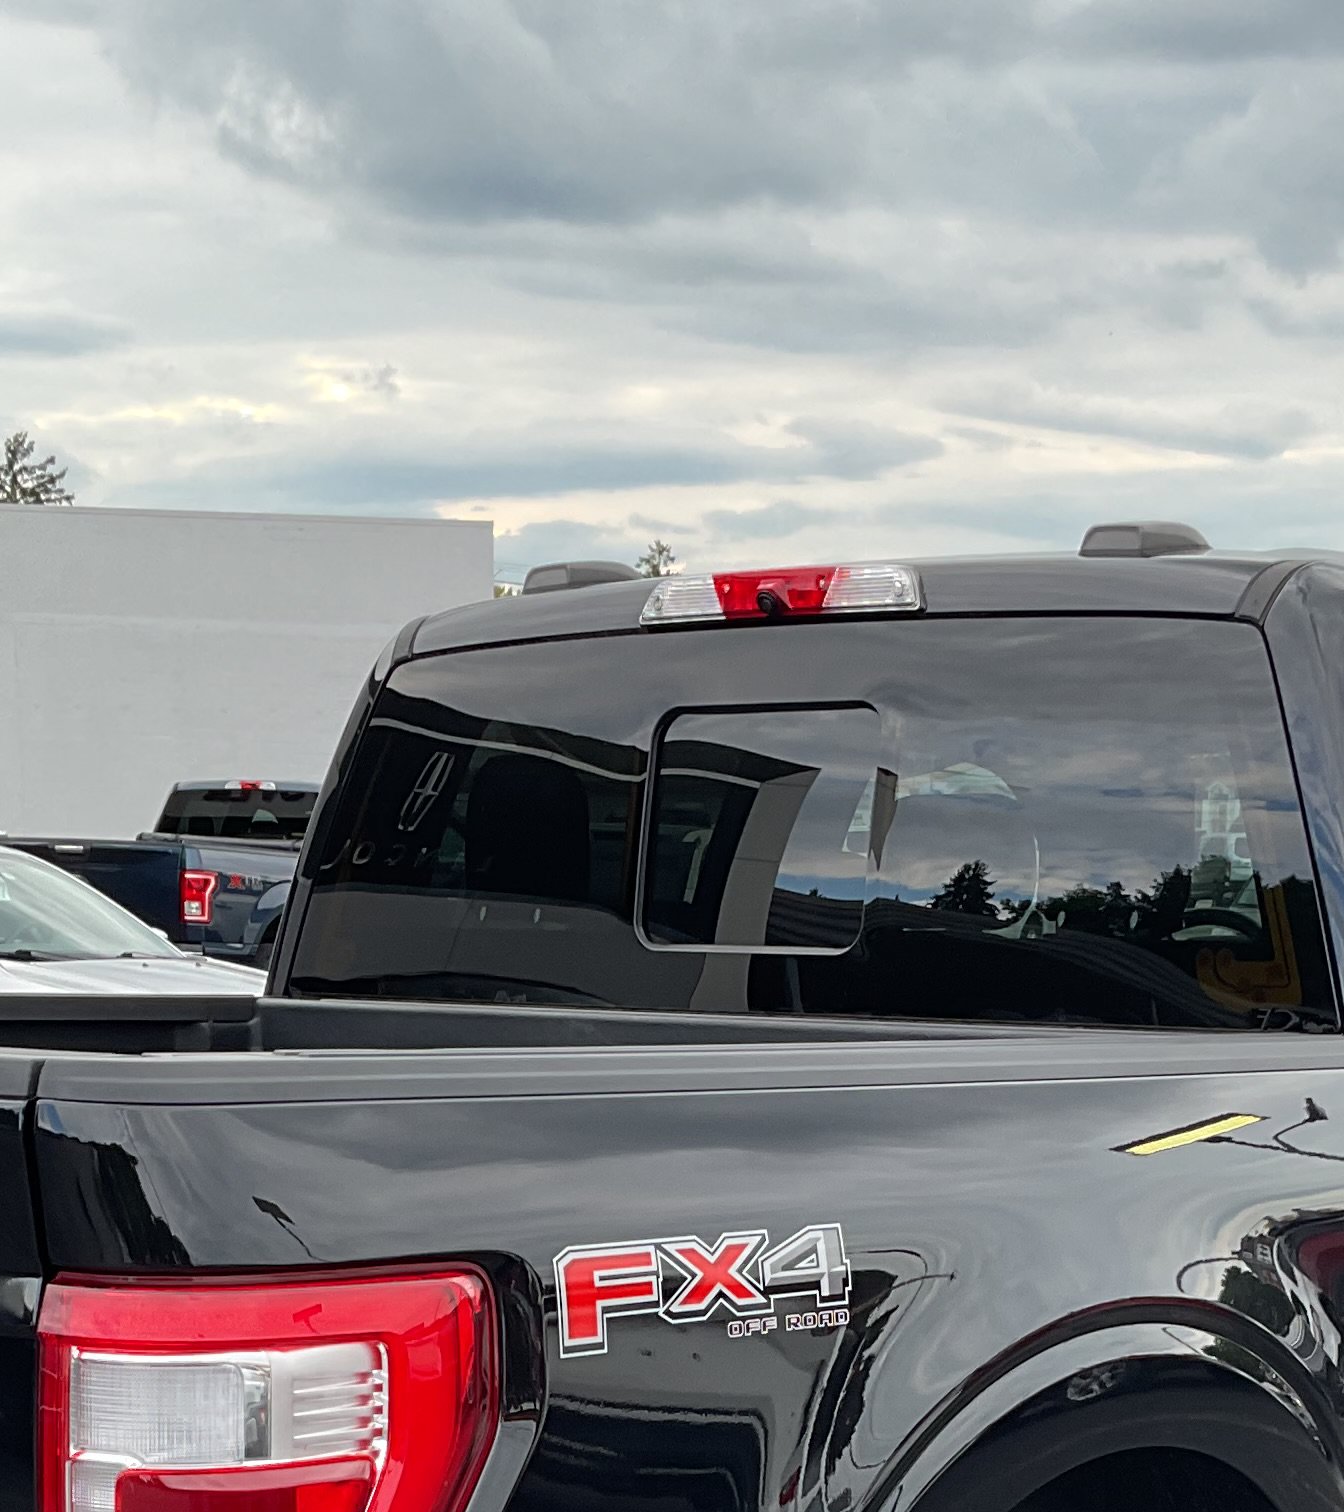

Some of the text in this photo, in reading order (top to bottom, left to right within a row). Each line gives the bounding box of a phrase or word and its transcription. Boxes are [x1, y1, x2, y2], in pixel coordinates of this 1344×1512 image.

[553, 1223, 853, 1360] FX4
[727, 1309, 850, 1339] OFF ROAD
